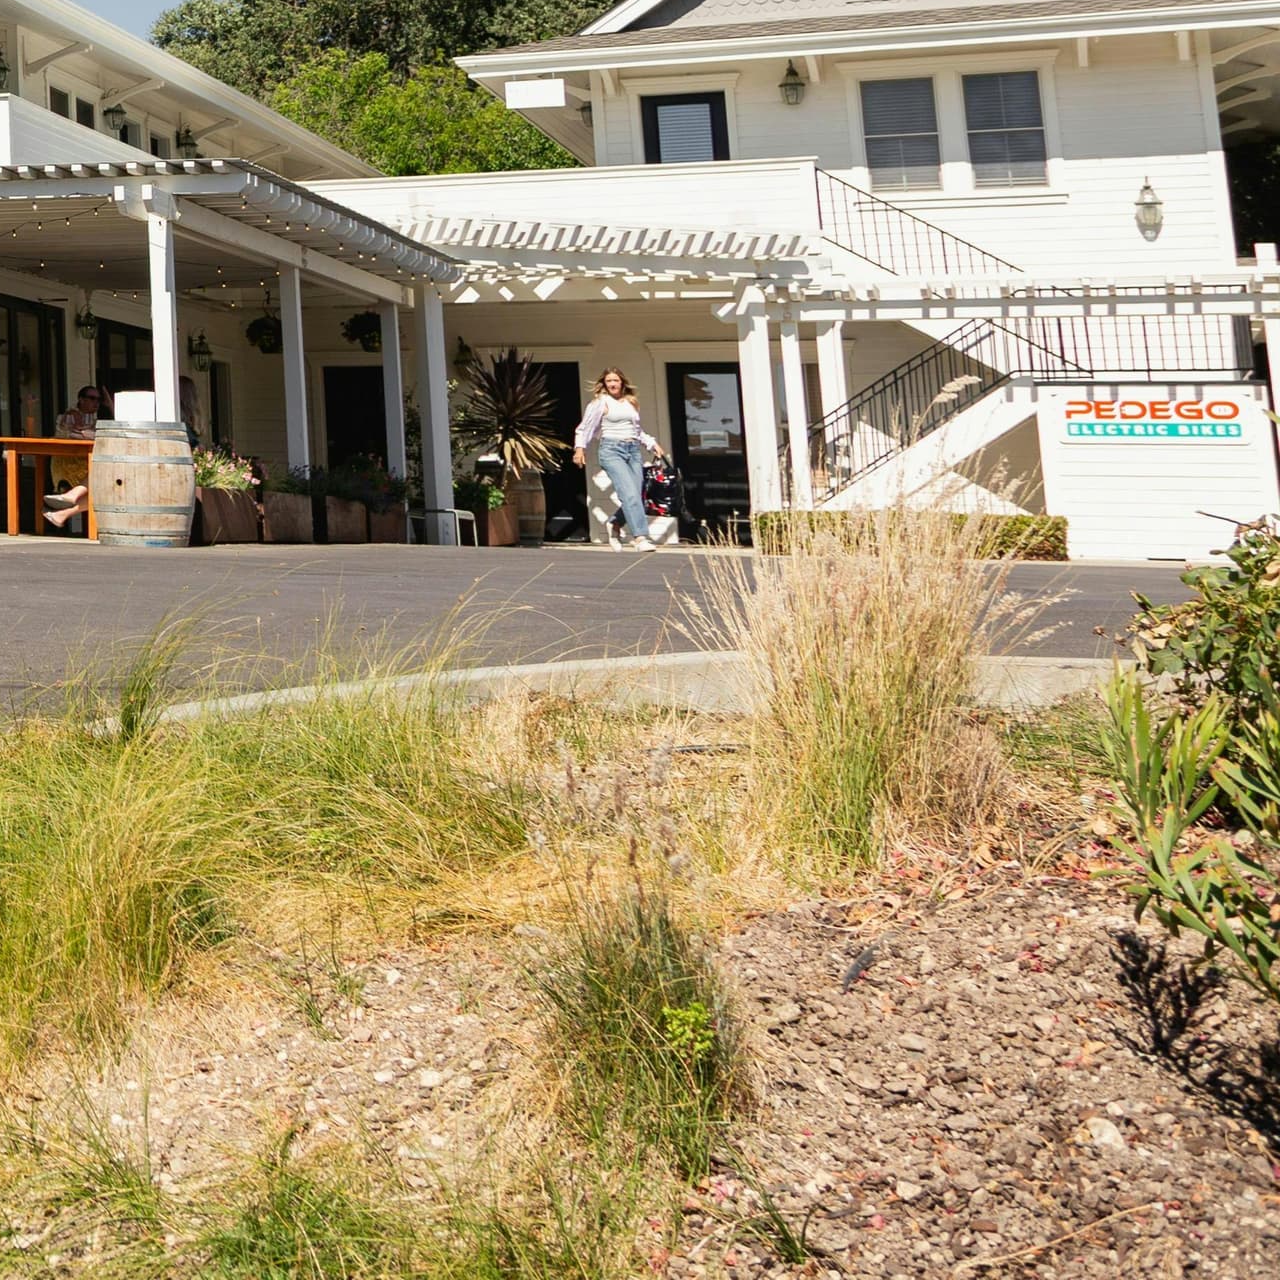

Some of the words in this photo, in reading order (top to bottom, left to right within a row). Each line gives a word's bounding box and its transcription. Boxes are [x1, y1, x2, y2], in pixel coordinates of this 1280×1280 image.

[1064, 400, 1239, 420] PEDEGO
[1069, 423, 1169, 435] ELECTRIC
[1177, 424, 1240, 436] BIKES
